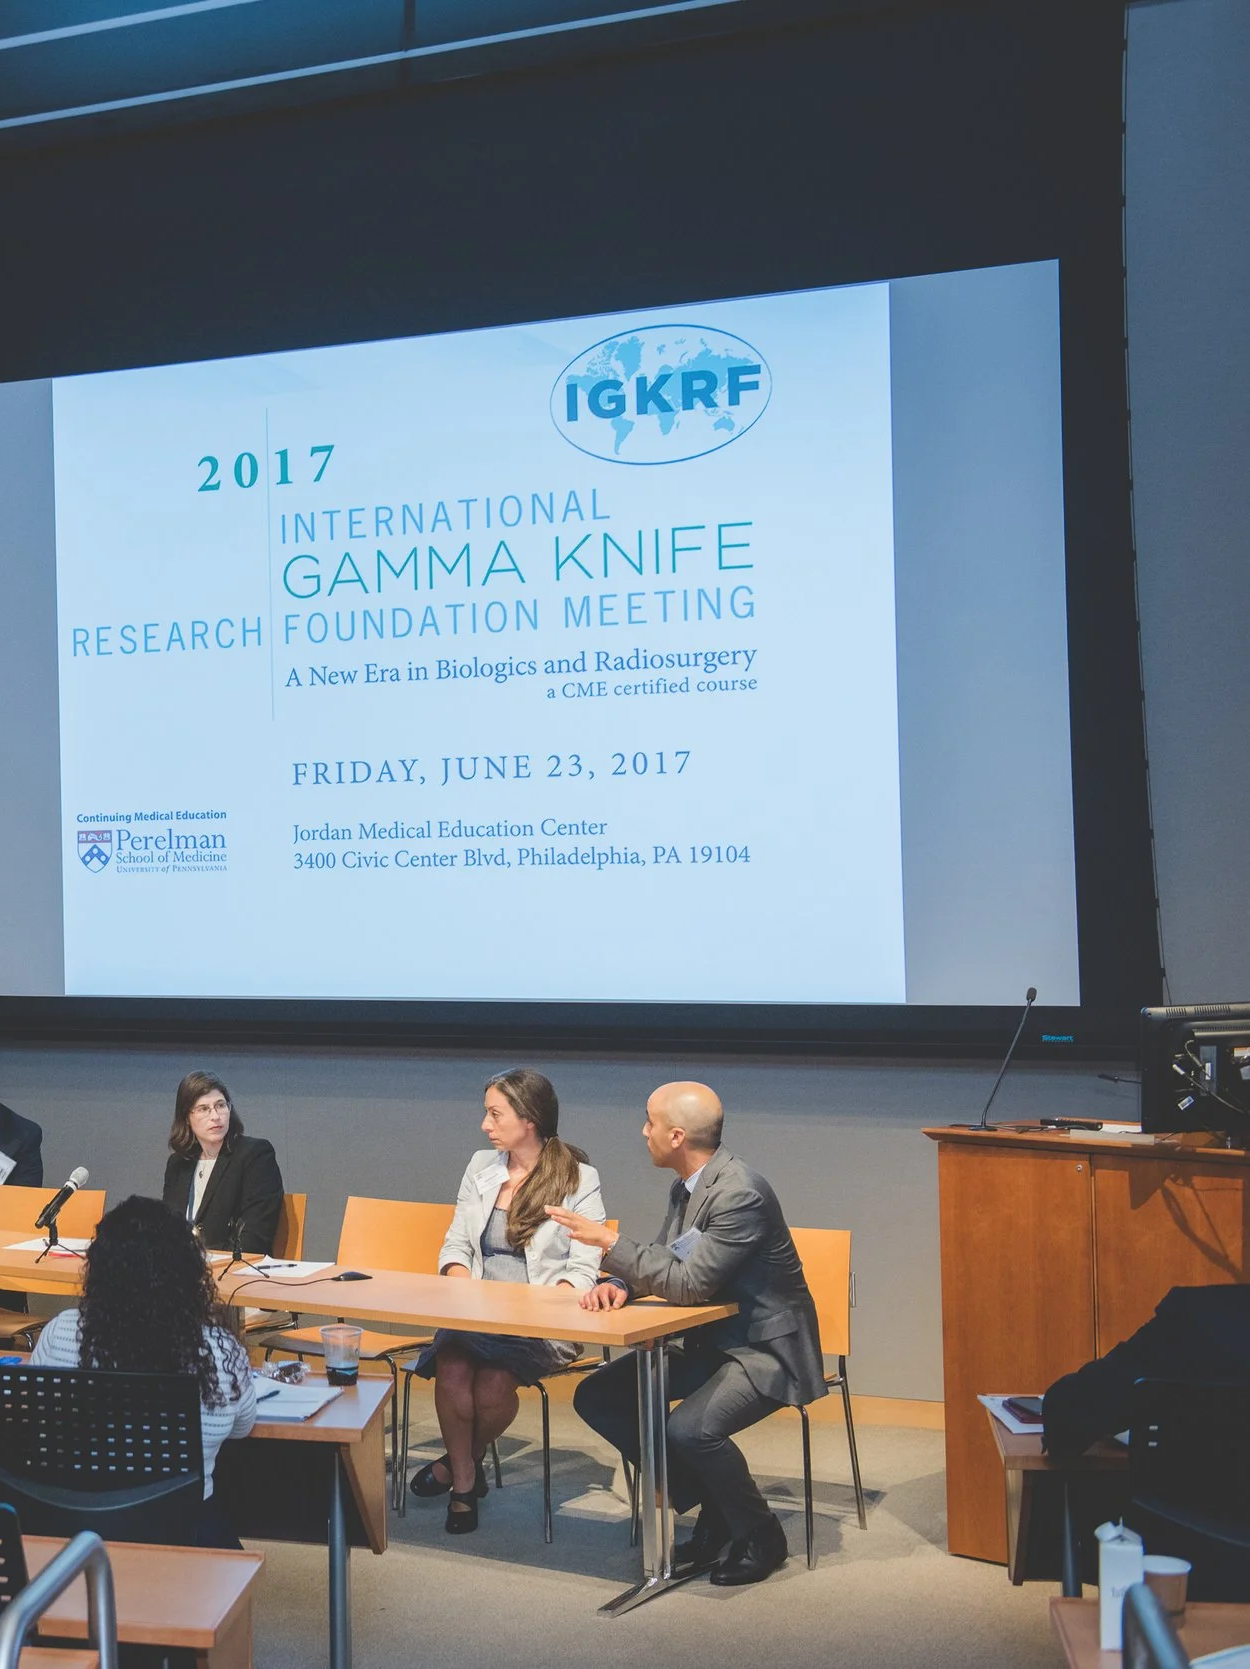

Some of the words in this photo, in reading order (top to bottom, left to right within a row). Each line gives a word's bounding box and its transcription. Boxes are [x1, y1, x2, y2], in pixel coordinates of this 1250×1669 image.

[566, 364, 761, 423] IGKRF
[197, 444, 335, 493] 2017
[281, 489, 611, 544] INTERNATIONAL
[282, 539, 525, 600] GAMMA
[554, 521, 754, 582] KNIFE
[72, 616, 262, 657] RESEARCH
[284, 598, 538, 645] FOUNDATION
[564, 584, 755, 629] MEETING
[285, 667, 303, 688] A
[308, 665, 359, 687] New
[364, 663, 402, 684] Era
[407, 661, 429, 681] in
[435, 656, 537, 684] Biologics
[543, 650, 588, 675] and
[594, 647, 758, 674] Radiosurgery
[546, 688, 556, 700] a
[561, 681, 608, 699] CME
[613, 676, 690, 697] certified
[696, 678, 758, 693] course
[292, 758, 426, 786] FRIDAY,
[441, 754, 532, 787] JUNE
[547, 753, 595, 780] 23,
[611, 750, 691, 776] 2017
[76, 812, 132, 824] Continuing
[133, 810, 174, 822] Medical
[175, 809, 227, 821] Education
[293, 822, 353, 845] Jordan
[358, 820, 432, 840] Medical
[437, 819, 535, 838] Education
[540, 818, 608, 837] Center
[116, 828, 227, 851] Perelman
[115, 850, 154, 864] School
[157, 849, 172, 863] of
[173, 849, 227, 863] Medicine
[160, 863, 171, 874] of
[293, 851, 337, 870] 3400
[341, 850, 389, 869] Civic
[394, 849, 458, 868] Center
[463, 847, 512, 869] Blvd,
[517, 845, 646, 871] Philadelphia,
[653, 845, 682, 865] PA
[690, 845, 751, 864] 19104
